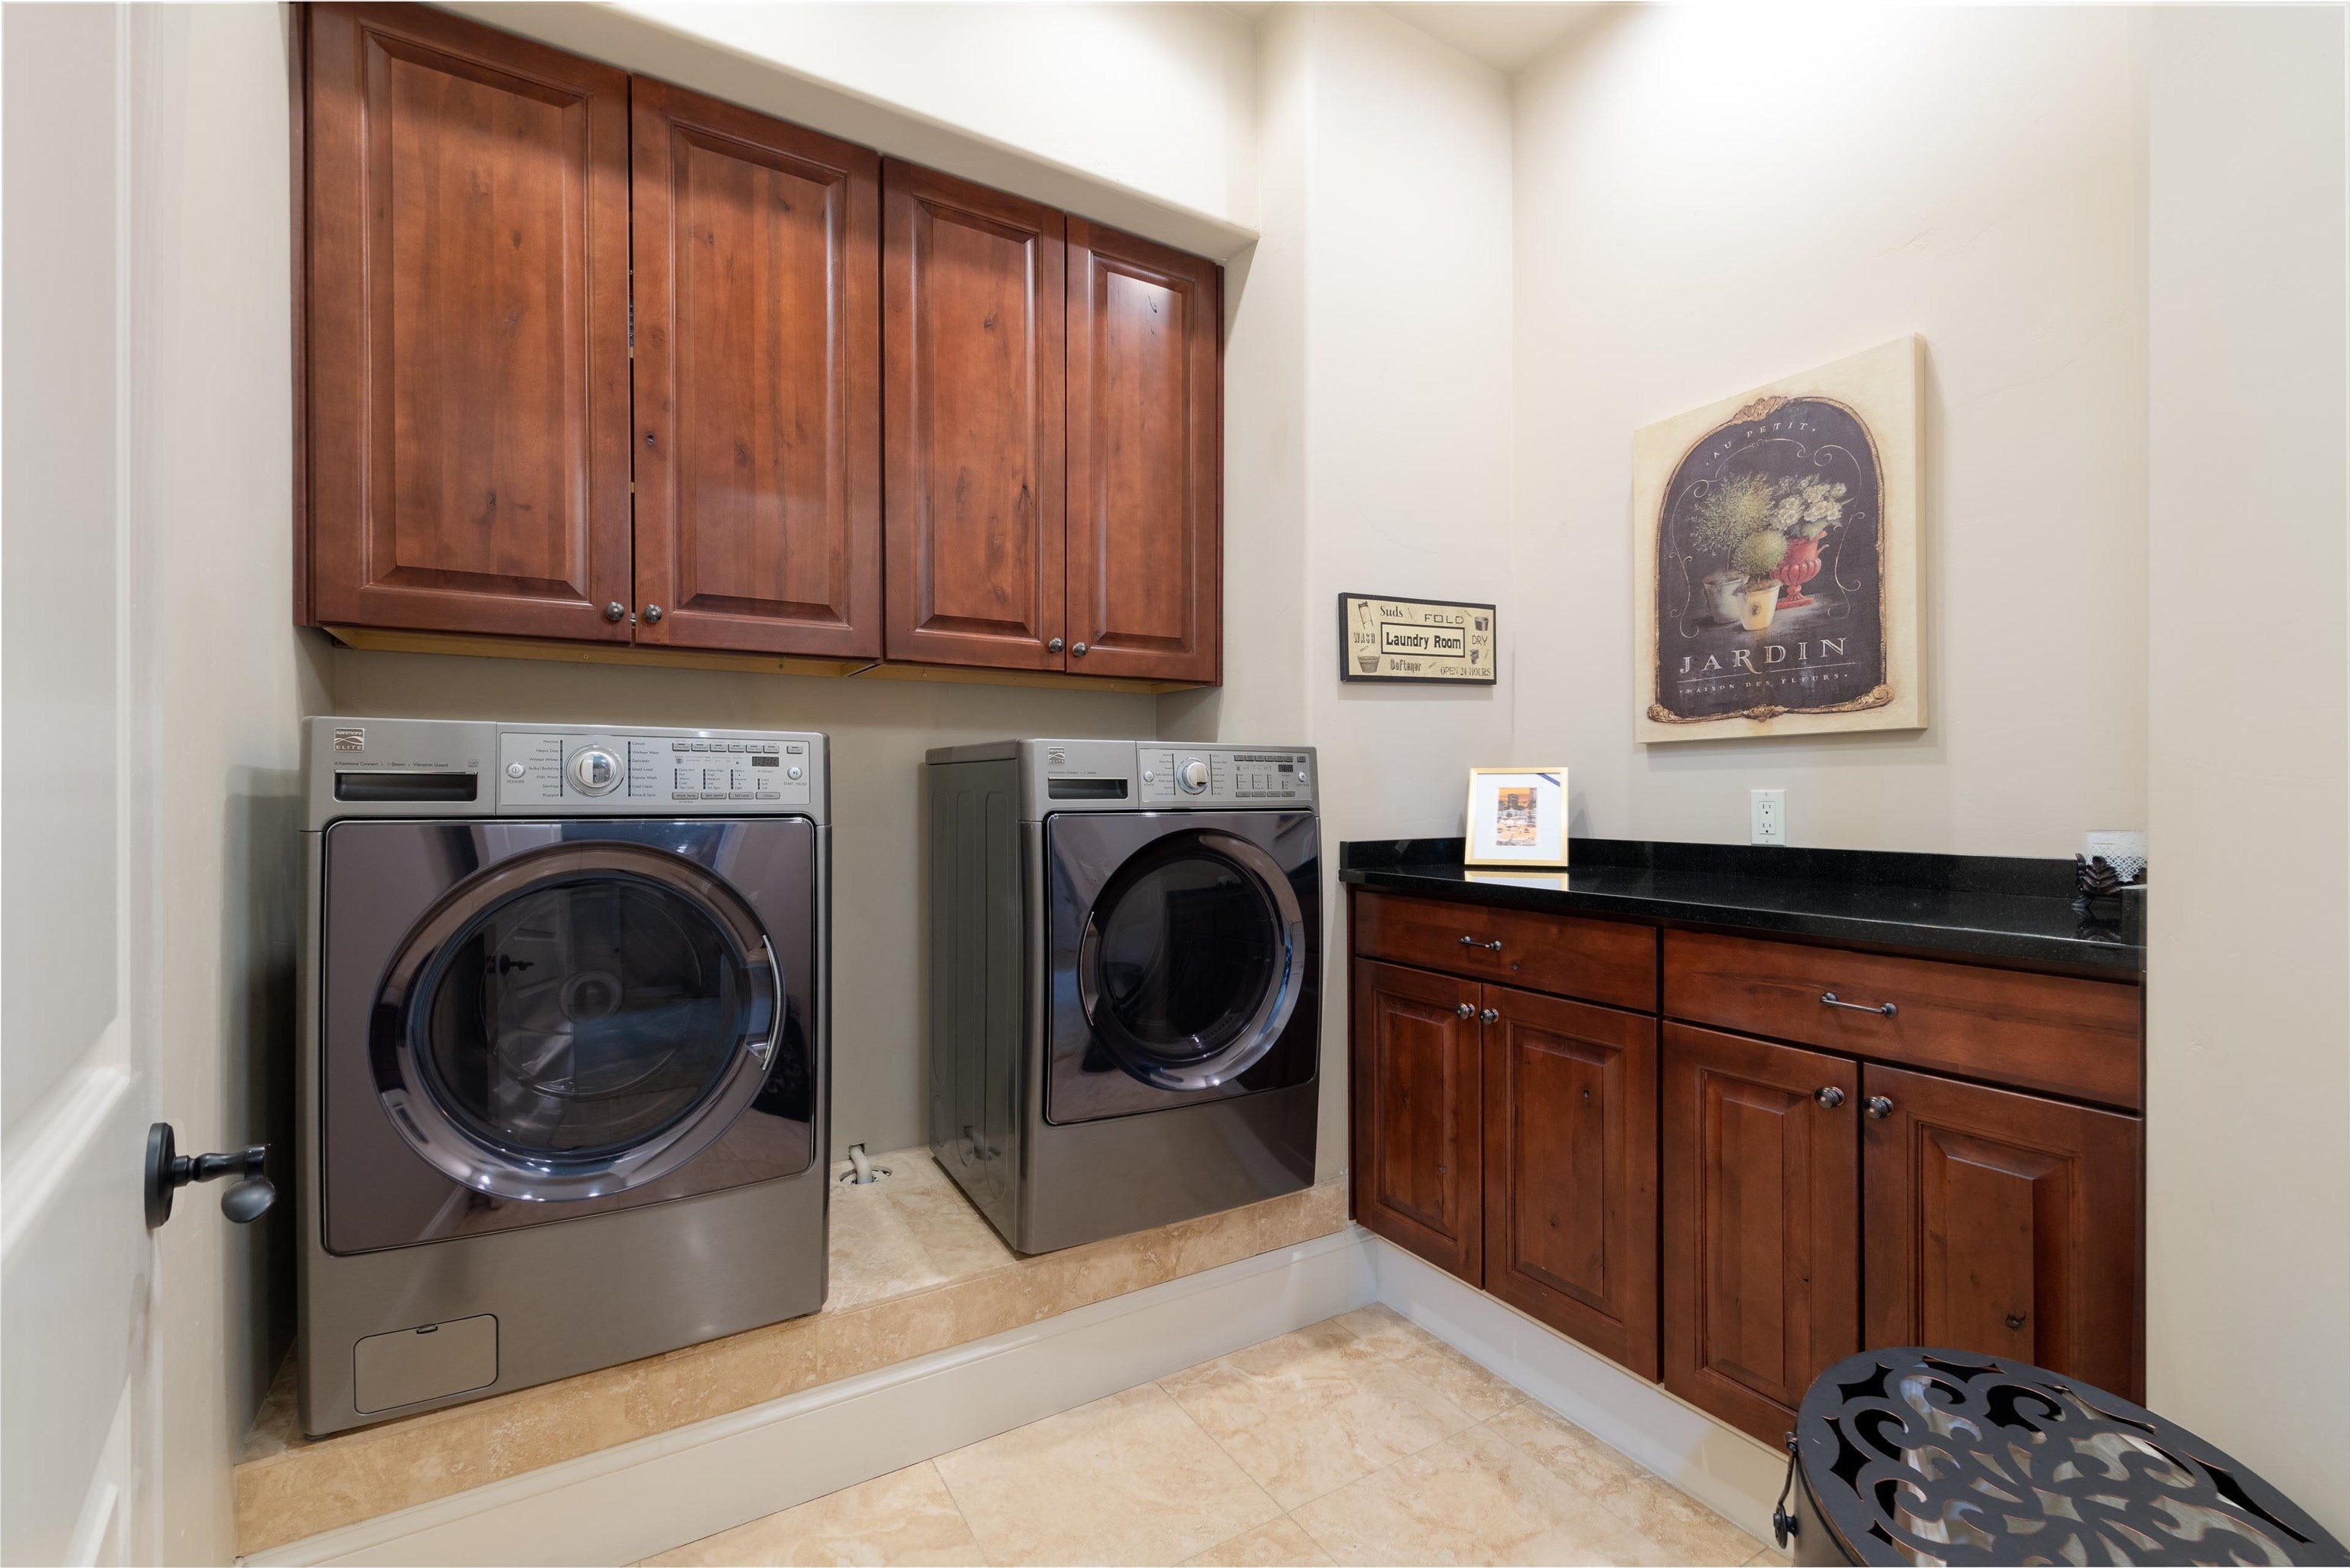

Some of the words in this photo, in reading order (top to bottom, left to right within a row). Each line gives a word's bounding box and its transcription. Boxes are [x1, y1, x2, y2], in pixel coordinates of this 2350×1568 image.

[1713, 441, 1733, 460] AU
[1746, 421, 1808, 438] PETIT
[1379, 605, 1404, 618] Suds
[1424, 613, 1465, 625] FOLD
[1353, 632, 1376, 644] WASH
[1385, 632, 1430, 650] Laundry
[1434, 635, 1462, 649] Room
[1471, 635, 1488, 646] DRY
[1679, 637, 1847, 675] JARDIN
[1389, 658, 1422, 673] Softener
[1440, 666, 1458, 676] OPEN
[1460, 668, 1467, 676] 24
[1469, 668, 1492, 677] HOURS
[1685, 683, 1736, 695] MAISON
[1745, 679, 1772, 688] DES
[1781, 672, 1840, 685] FLEURS
